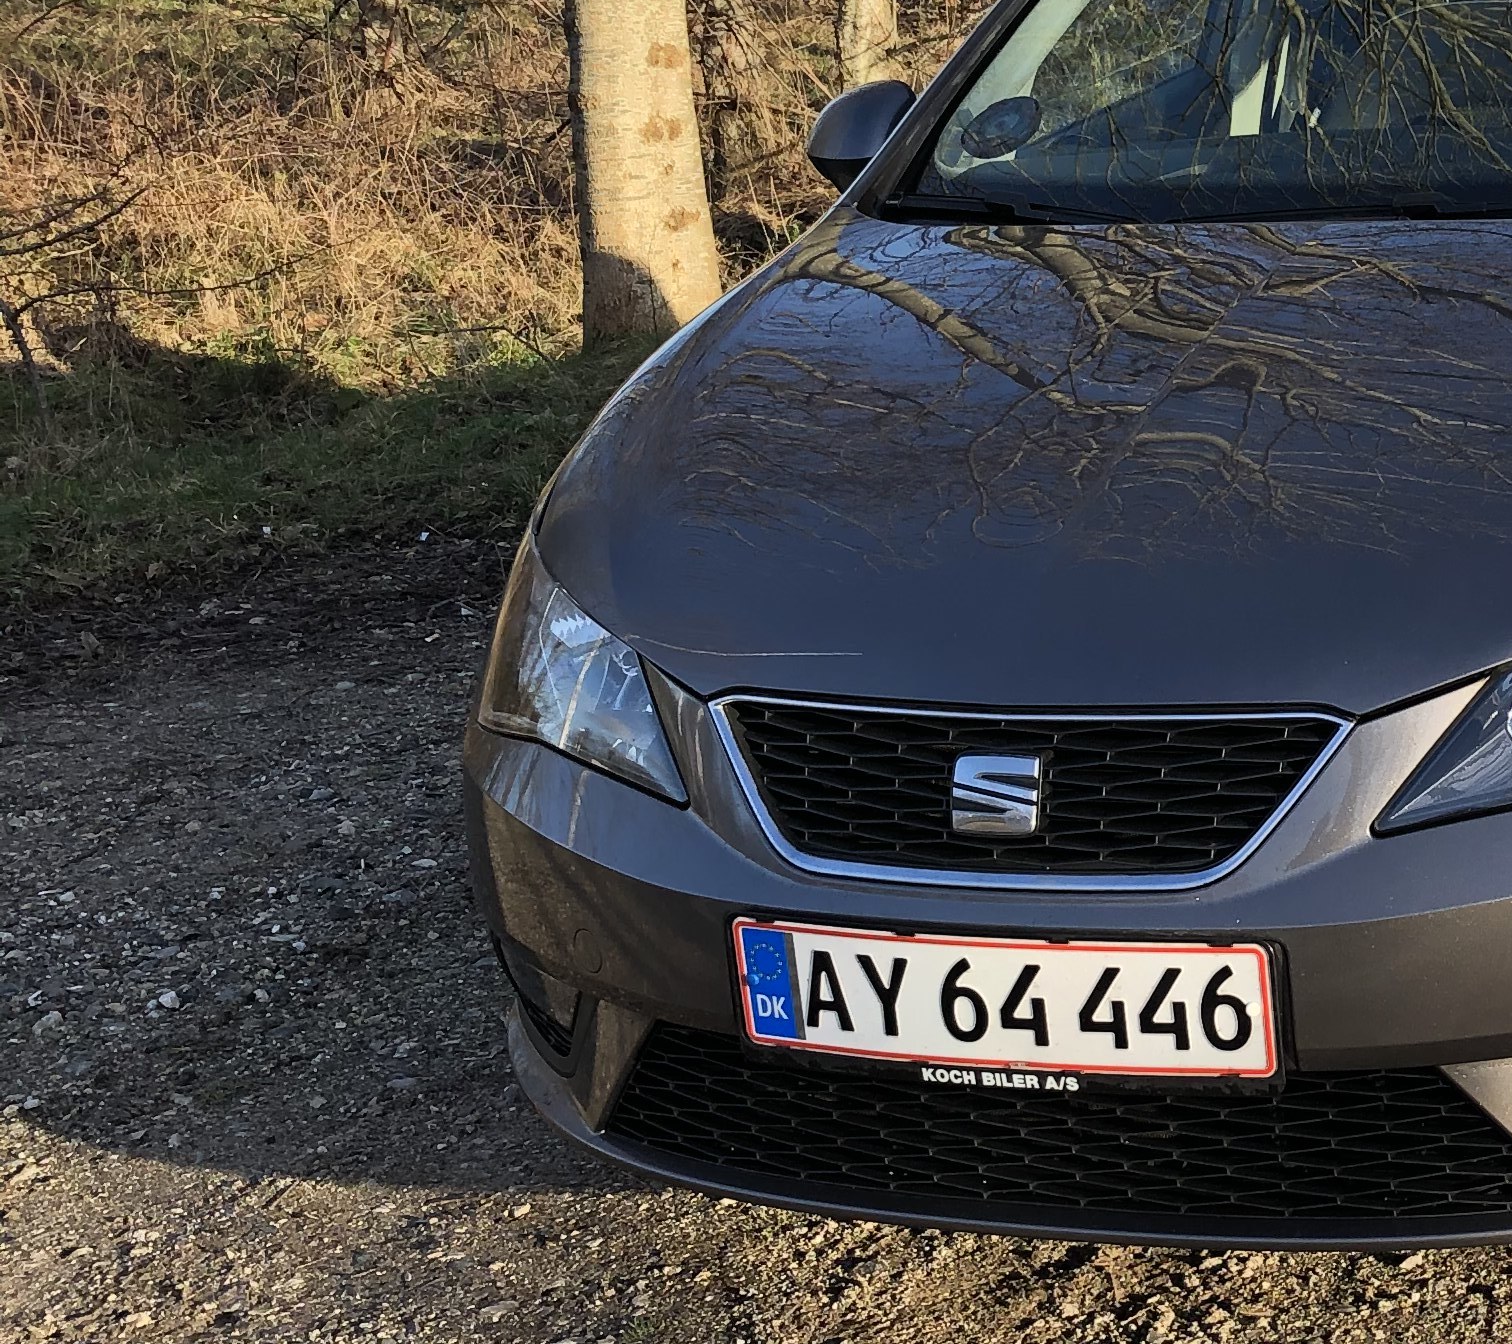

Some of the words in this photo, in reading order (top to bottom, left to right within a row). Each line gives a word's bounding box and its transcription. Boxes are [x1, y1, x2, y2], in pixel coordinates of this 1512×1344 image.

[756, 993, 790, 1020] DK
[806, 950, 908, 1036] AY
[940, 957, 1050, 1047] 64
[1078, 964, 1253, 1052] 446
[921, 1067, 976, 1085] KOCH
[981, 1072, 1040, 1089] BILER
[1044, 1076, 1079, 1091] A/S
